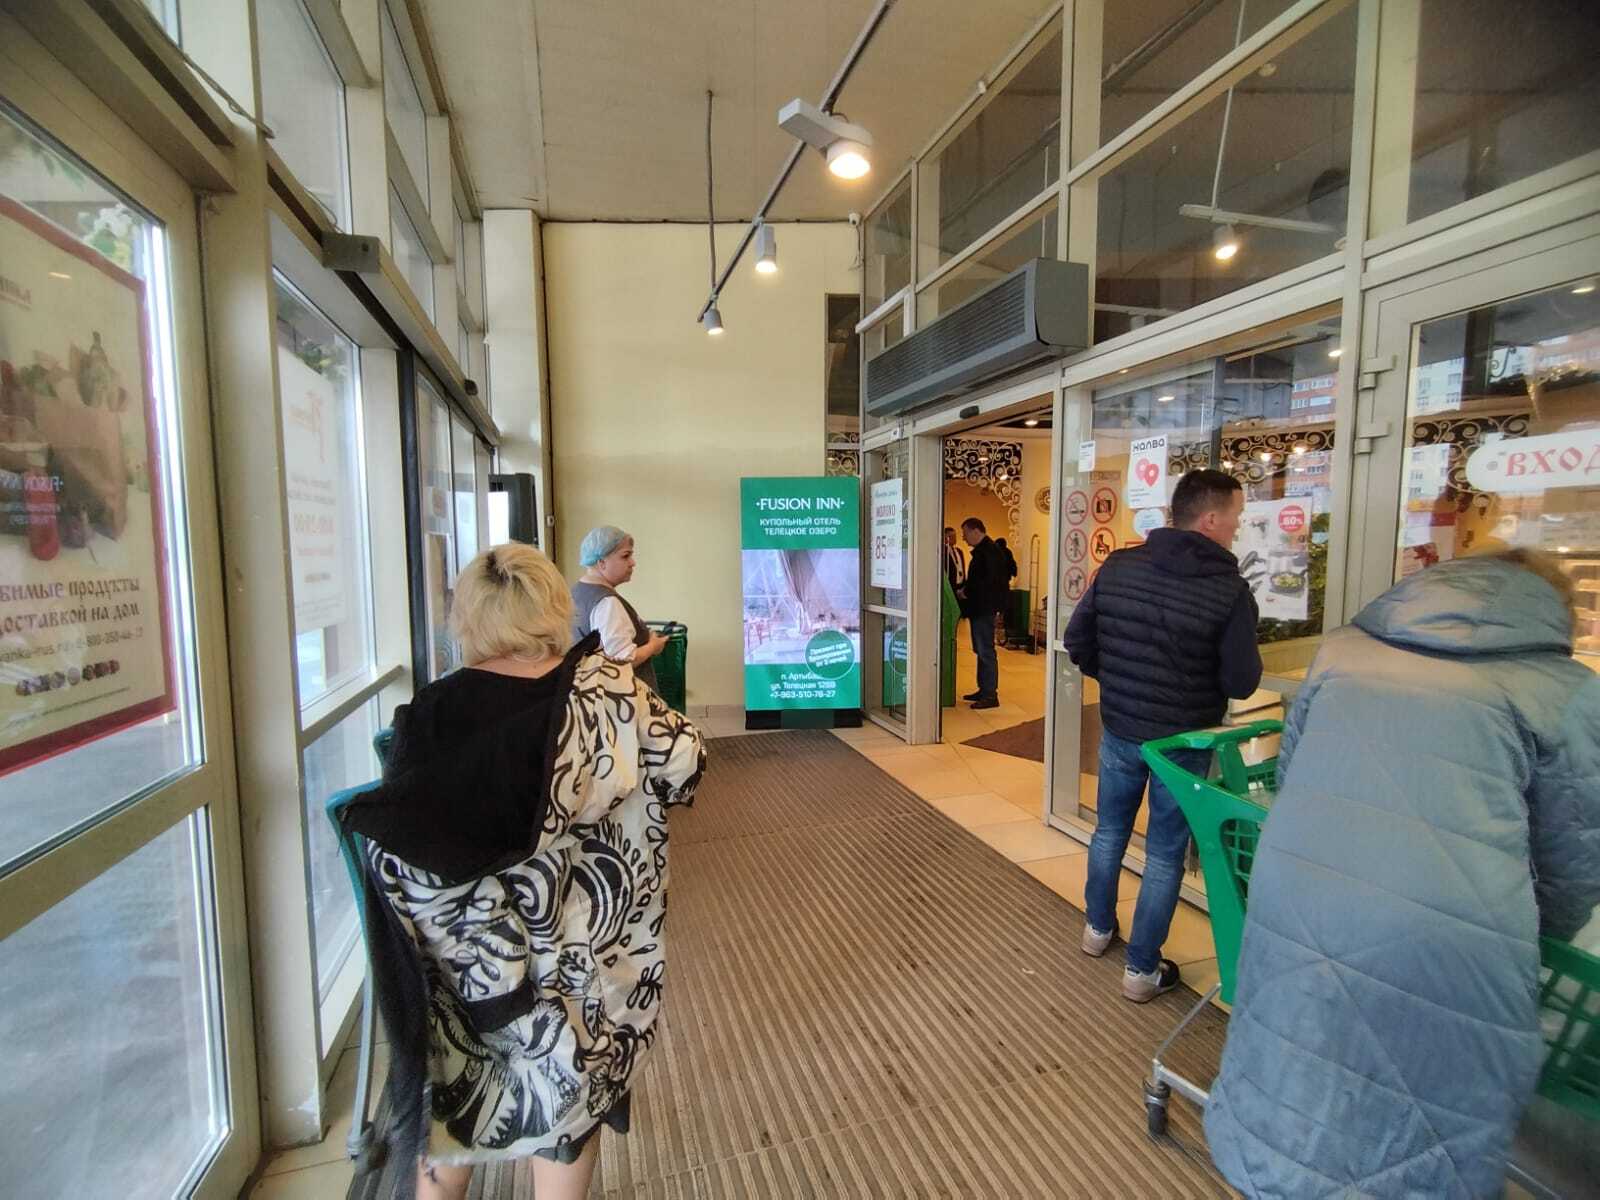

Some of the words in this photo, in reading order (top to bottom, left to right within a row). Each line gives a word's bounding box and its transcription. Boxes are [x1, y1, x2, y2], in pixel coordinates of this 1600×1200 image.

[759, 516, 812, 526] КУПОЛЬНЫЙ
[813, 517, 842, 526] ОТЕЛЬ
[765, 527, 807, 537] ТЕЛЕЦКОЕ
[808, 527, 837, 536] ОЗЕРО
[875, 535, 887, 560] 85
[68, 578, 141, 601] продукты
[0, 605, 88, 636] оставкой
[91, 606, 109, 620] на
[113, 602, 141, 621] дом
